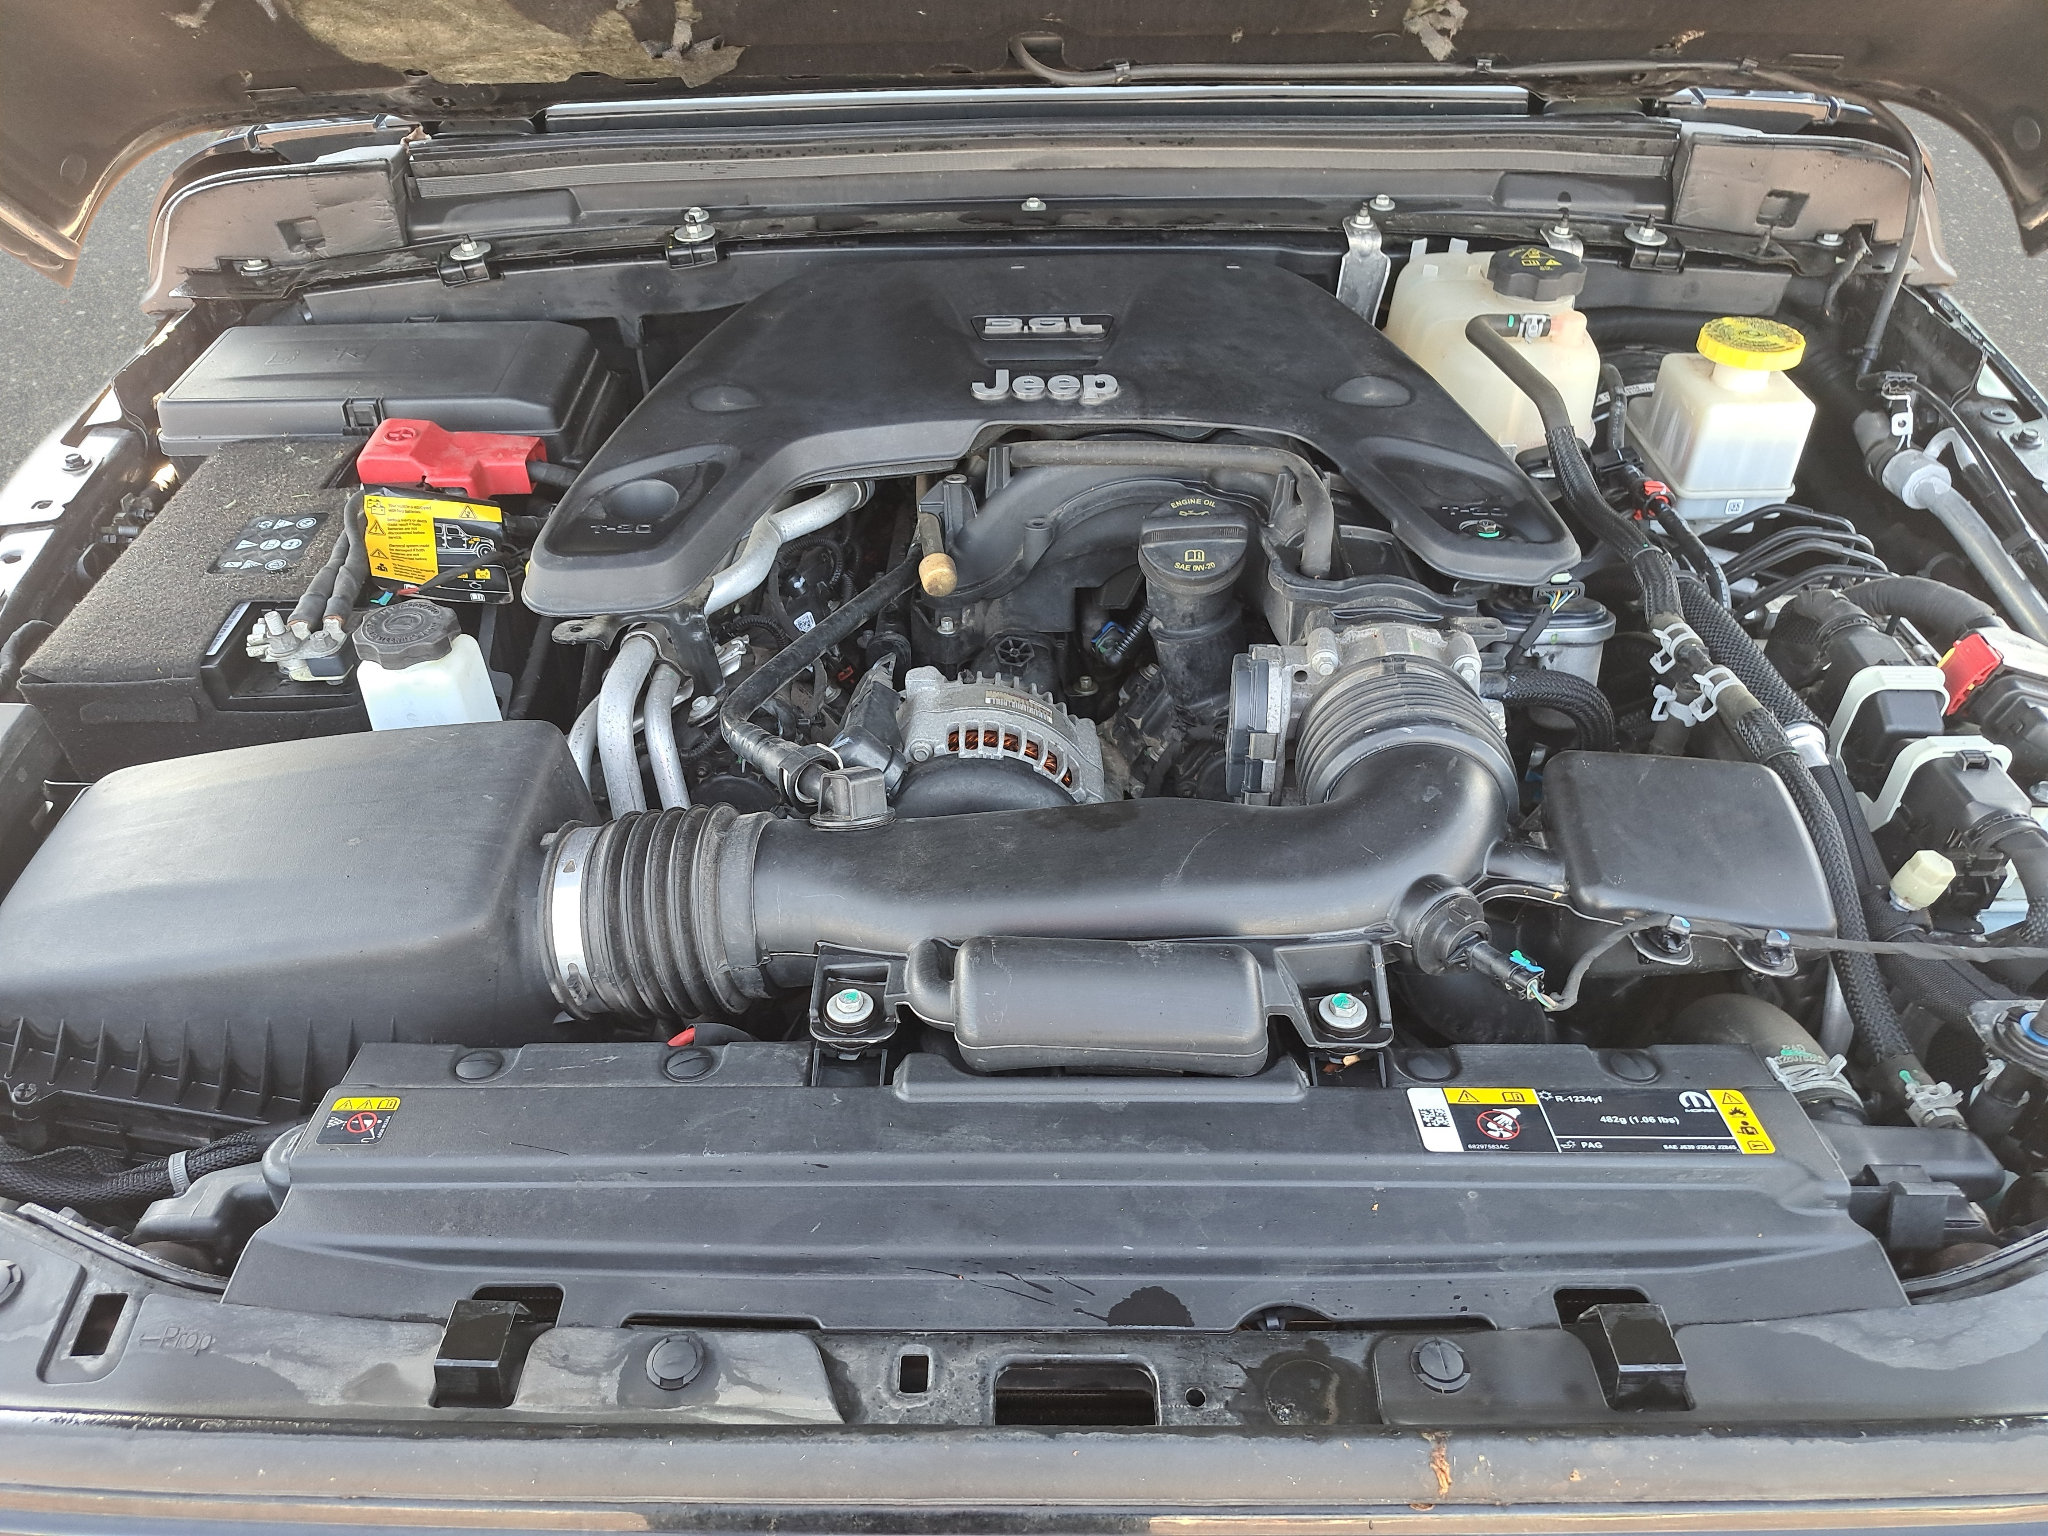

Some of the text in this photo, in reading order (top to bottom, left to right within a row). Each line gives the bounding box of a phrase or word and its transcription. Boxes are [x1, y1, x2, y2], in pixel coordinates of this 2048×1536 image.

[971, 369, 1119, 405] Jeep
[1170, 498, 1216, 509] ENGINE OIL
[1174, 562, 1216, 572] SAE 0W-20
[1555, 1095, 1603, 1104] R-1234yf
[1600, 1116, 1680, 1126] 482g (1.06 lbs)
[159, 1327, 213, 1357] Prop
